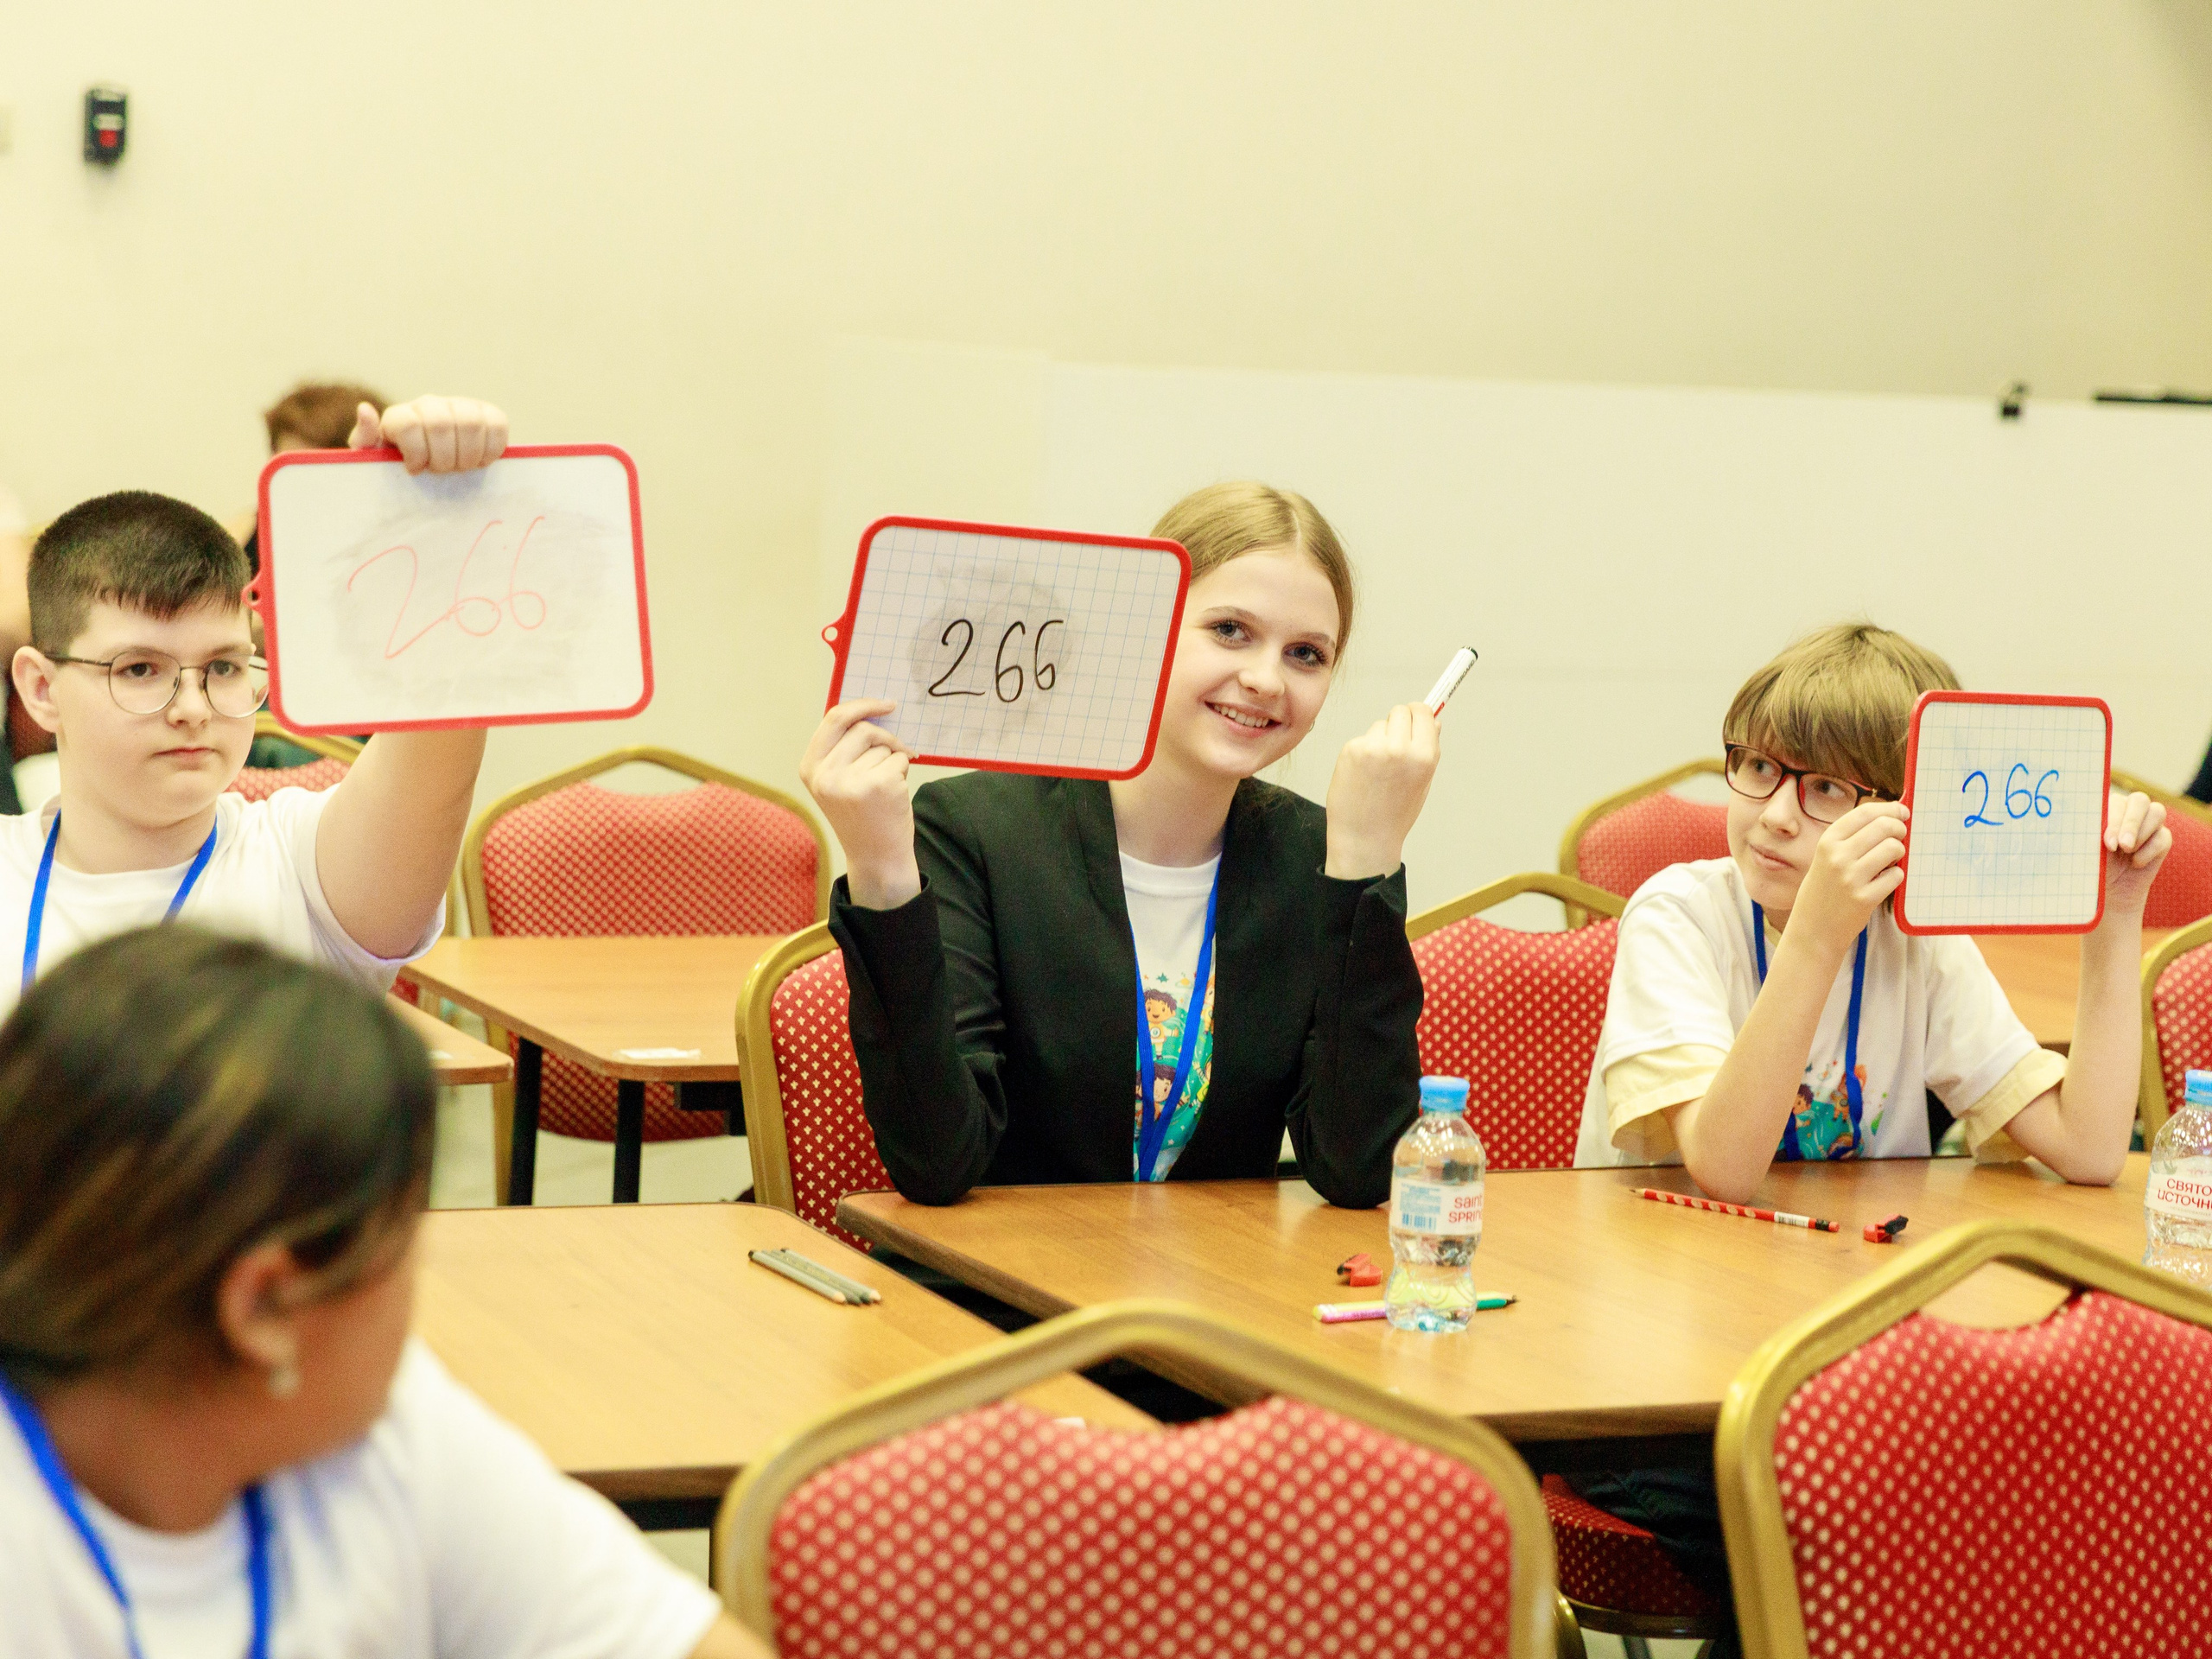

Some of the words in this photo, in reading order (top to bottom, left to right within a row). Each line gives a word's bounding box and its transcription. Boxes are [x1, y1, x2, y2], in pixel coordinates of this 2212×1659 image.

[347, 516, 546, 659] 266
[927, 619, 1065, 703] 266
[1961, 762, 2060, 829] 266
[2157, 1188, 2212, 1210] ИСТОЧН
[2166, 1178, 2212, 1197] СВЯТО
